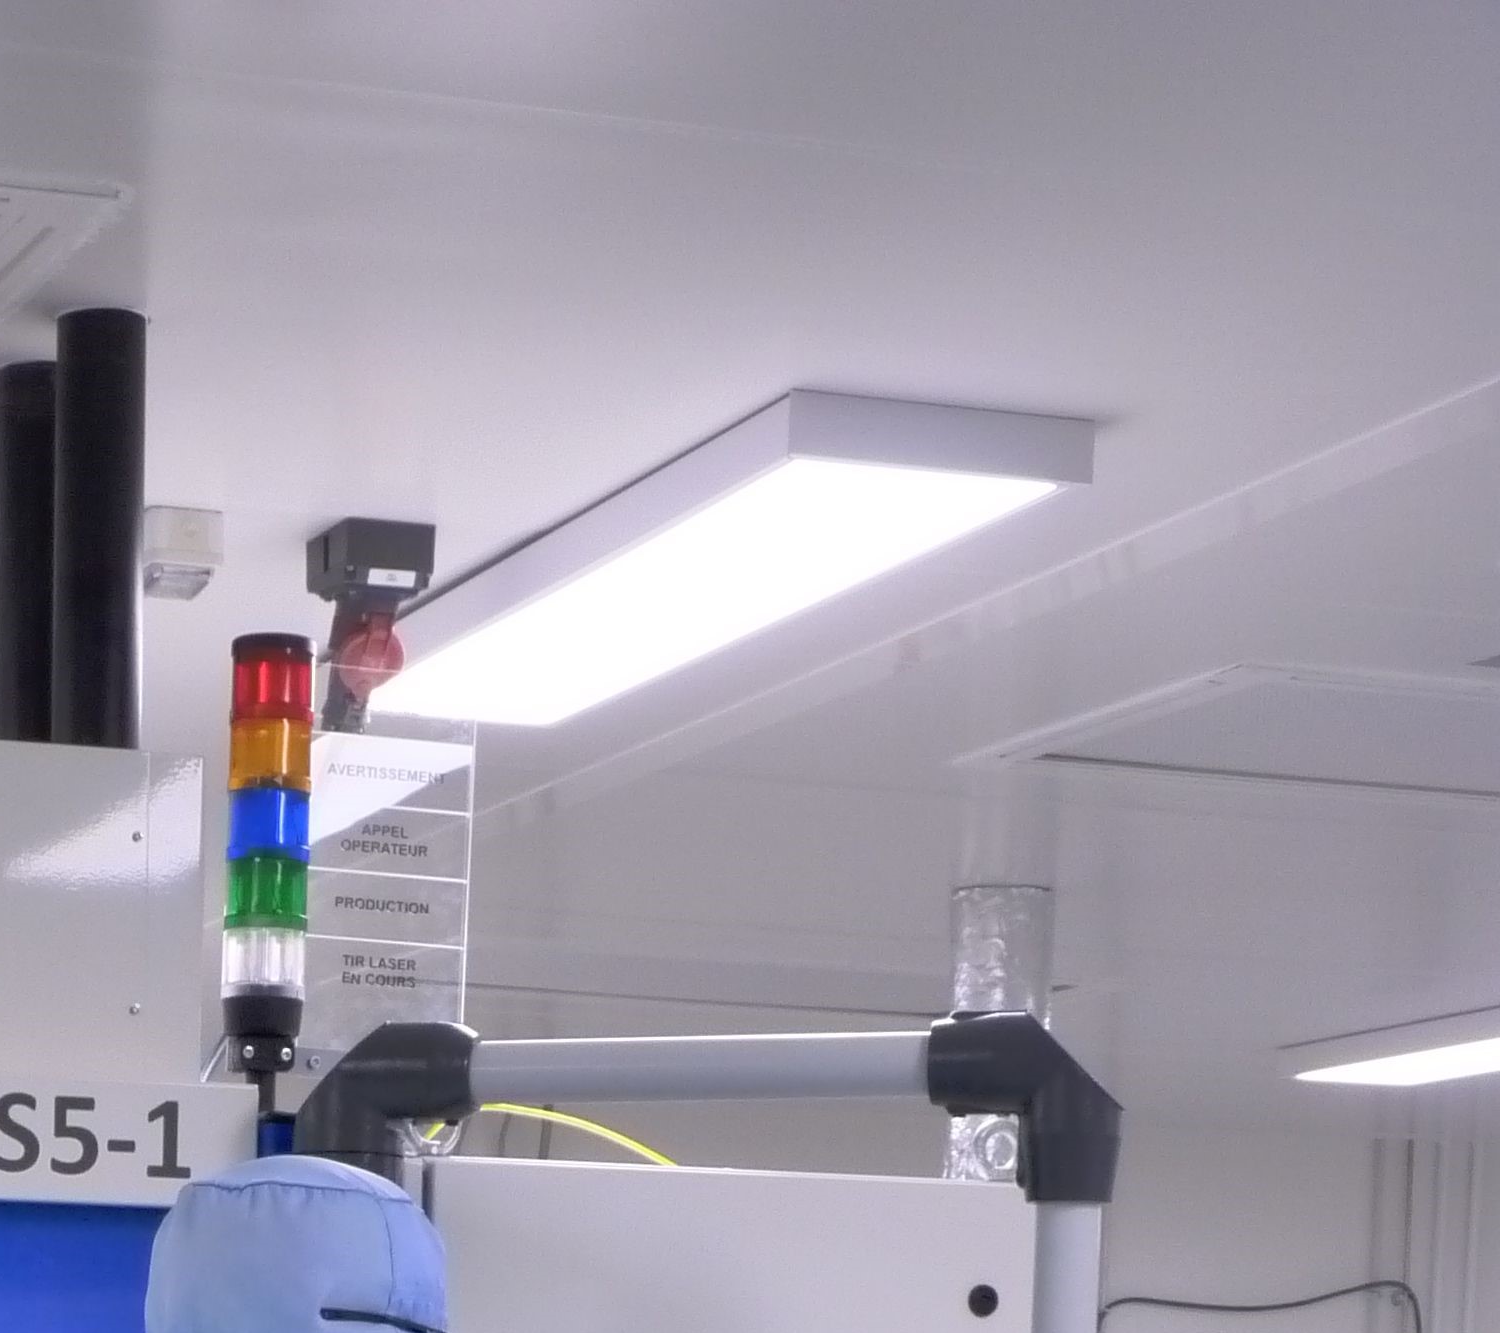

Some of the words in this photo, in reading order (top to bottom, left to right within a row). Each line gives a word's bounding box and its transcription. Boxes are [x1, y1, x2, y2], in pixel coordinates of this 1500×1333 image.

[327, 762, 446, 785] AVERTISSEMENT
[361, 823, 409, 840] APPEL
[340, 838, 429, 858] OPERATEUR
[334, 896, 430, 916] PRODUCTION
[342, 953, 366, 969] TIR
[369, 955, 417, 972] LASER
[341, 971, 361, 986] EN
[364, 973, 417, 989] COURS
